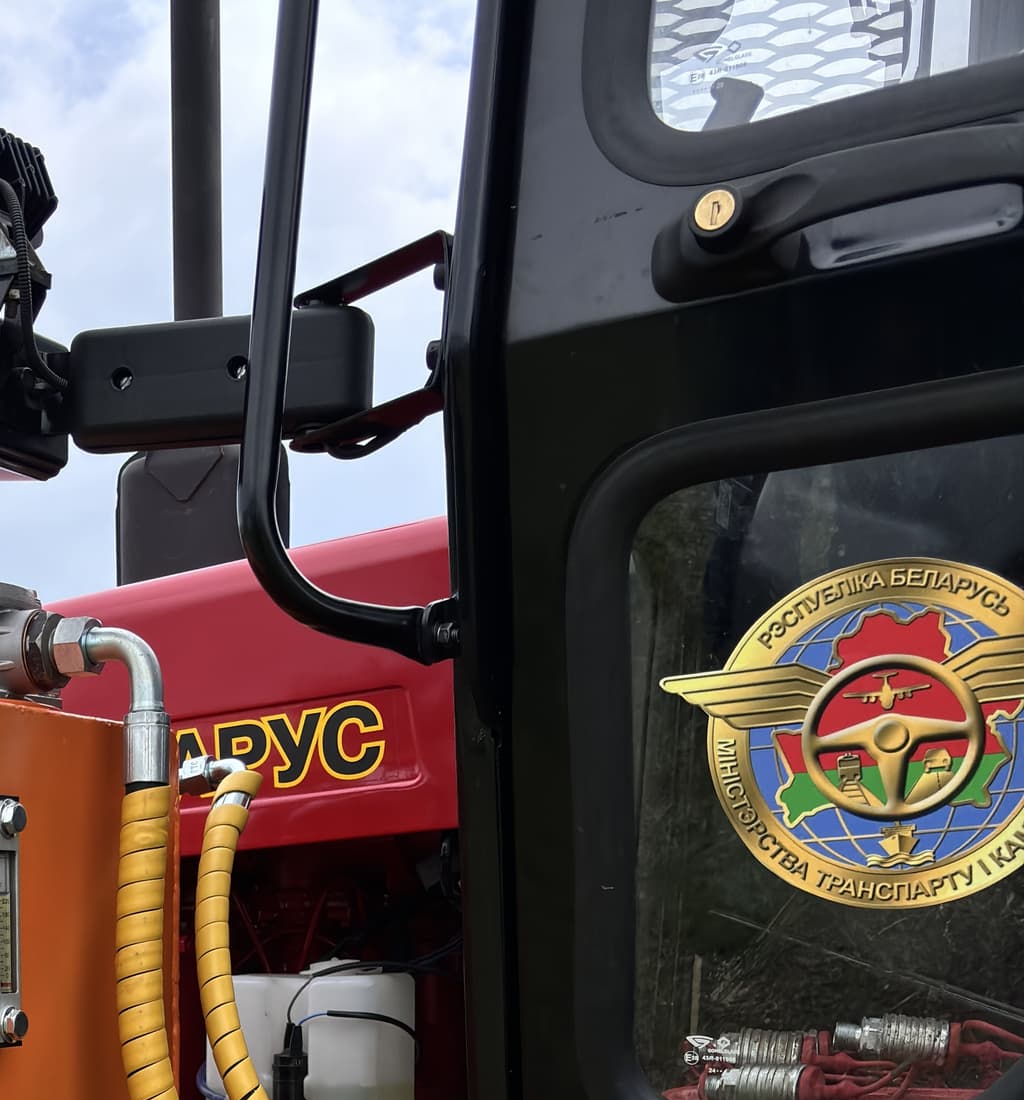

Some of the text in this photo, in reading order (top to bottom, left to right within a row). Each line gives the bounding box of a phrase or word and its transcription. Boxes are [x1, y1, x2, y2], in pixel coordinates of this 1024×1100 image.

[757, 567, 1011, 650] РЭСПУБЛІКА БЕЛАРУСЬ
[717, 737, 810, 881] МІНІСТЭРСТВА
[815, 864, 973, 901] ТРАНСПАРТУ
